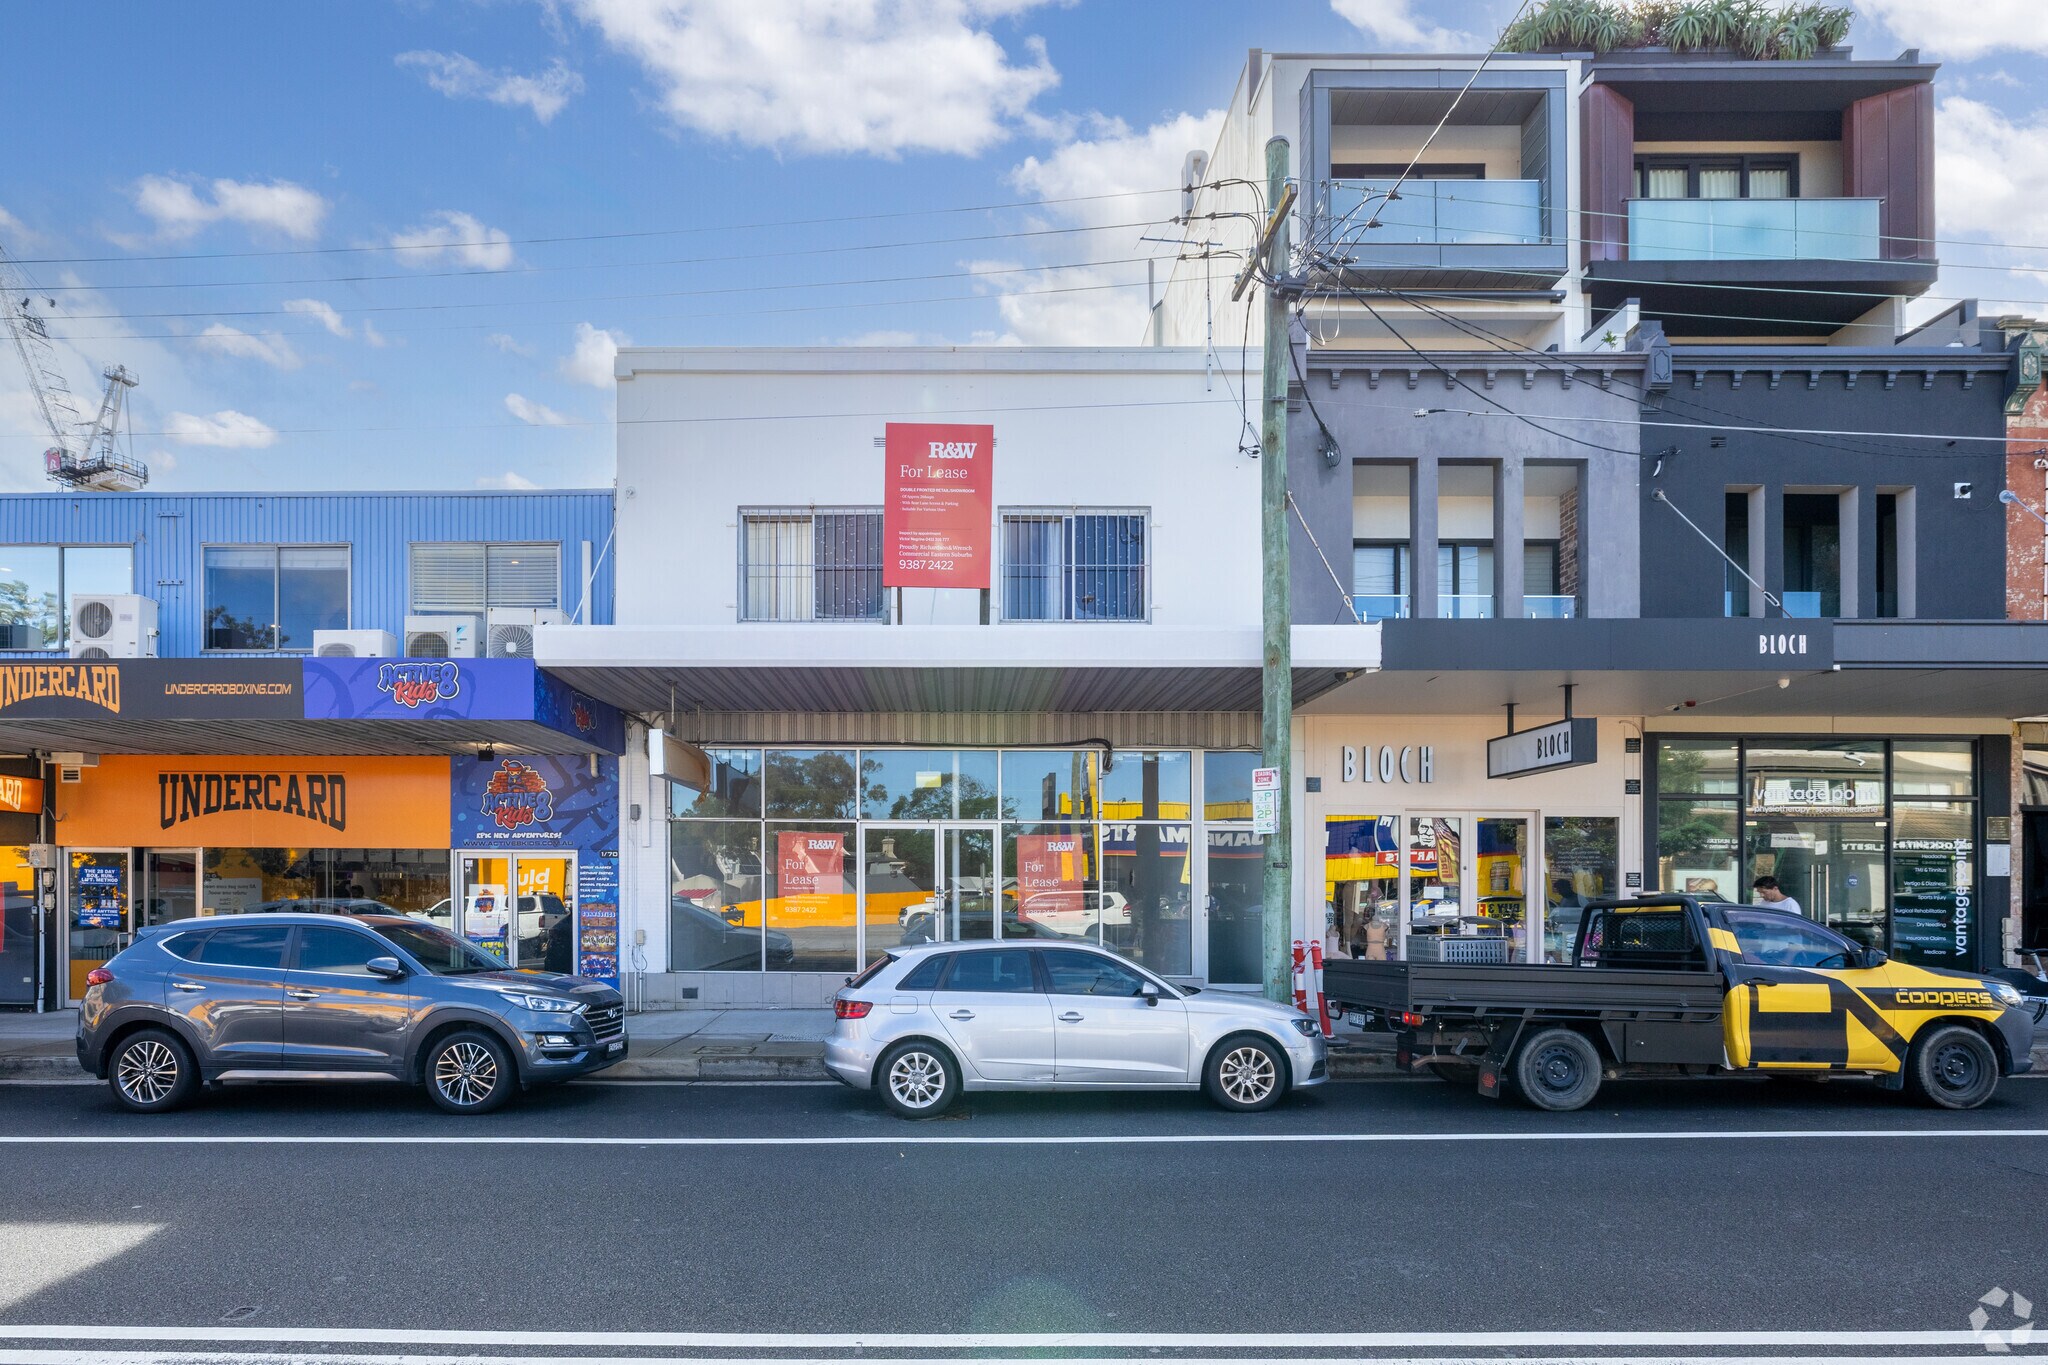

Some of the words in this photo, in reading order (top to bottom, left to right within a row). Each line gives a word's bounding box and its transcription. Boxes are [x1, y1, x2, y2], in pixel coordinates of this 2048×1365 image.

[928, 442, 977, 459] R&W
[900, 464, 923, 478] For
[927, 465, 968, 479] Lease
[898, 559, 927, 570] 9387
[927, 560, 954, 571] 2422
[1759, 634, 1807, 654] BLOCH
[0, 665, 120, 714] NDERCARD
[165, 683, 292, 695] UNDERCARDBOXING.COM
[394, 680, 438, 707] Kids
[1537, 730, 1569, 760] BLOCH
[1342, 745, 1434, 784] BLOCH
[159, 773, 347, 832] UNDERCARD
[1753, 788, 1826, 805] vantage
[1831, 788, 1879, 805] point
[494, 806, 534, 829] Kids
[808, 840, 836, 850] R&W
[1047, 841, 1075, 852] R&W
[785, 858, 805, 870] For
[1024, 861, 1044, 873] For
[785, 873, 819, 885] Lease
[1024, 876, 1059, 888] Lease
[1953, 885, 1970, 956] vantage
[1895, 991, 1993, 1005] COOPERS
